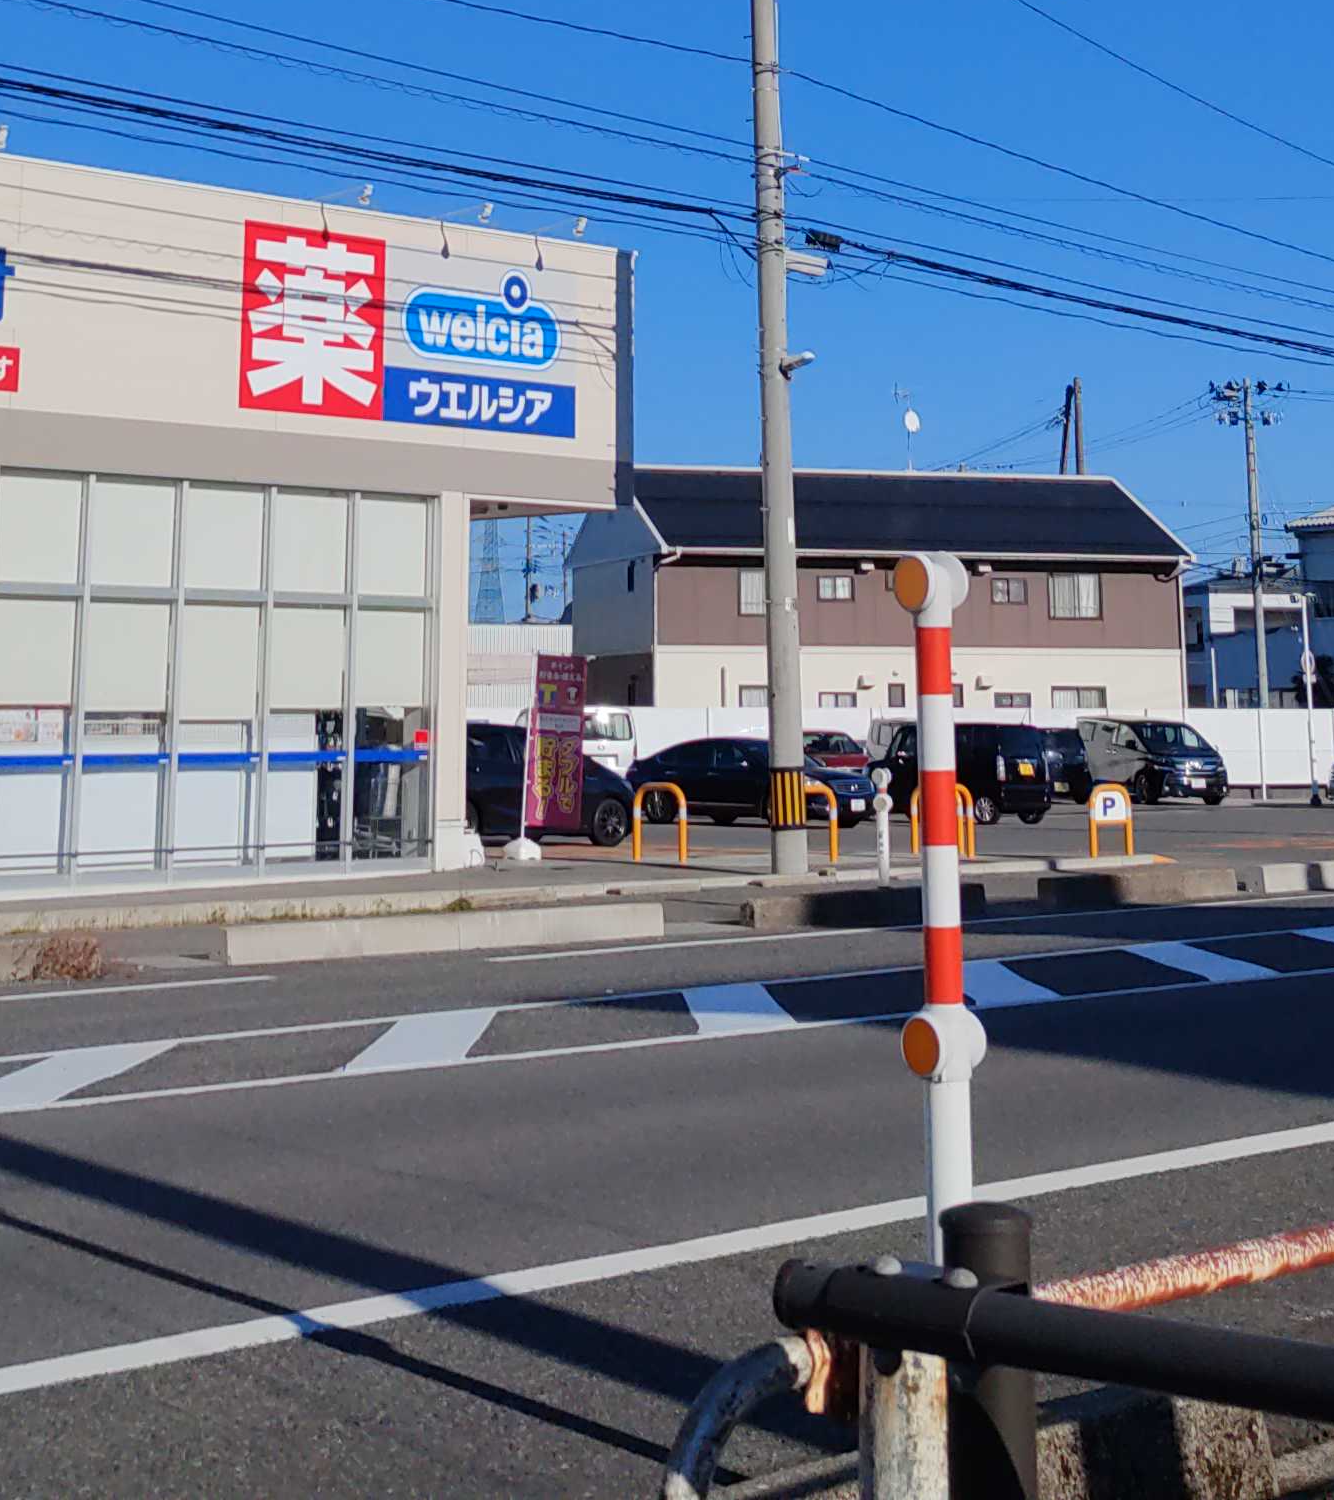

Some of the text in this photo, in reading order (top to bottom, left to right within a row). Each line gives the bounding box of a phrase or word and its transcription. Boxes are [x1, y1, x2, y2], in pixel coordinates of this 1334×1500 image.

[246, 235, 378, 407] 薬
[419, 285, 544, 359] welcia
[408, 377, 552, 425] ウエルシア
[1102, 796, 1116, 817] P
